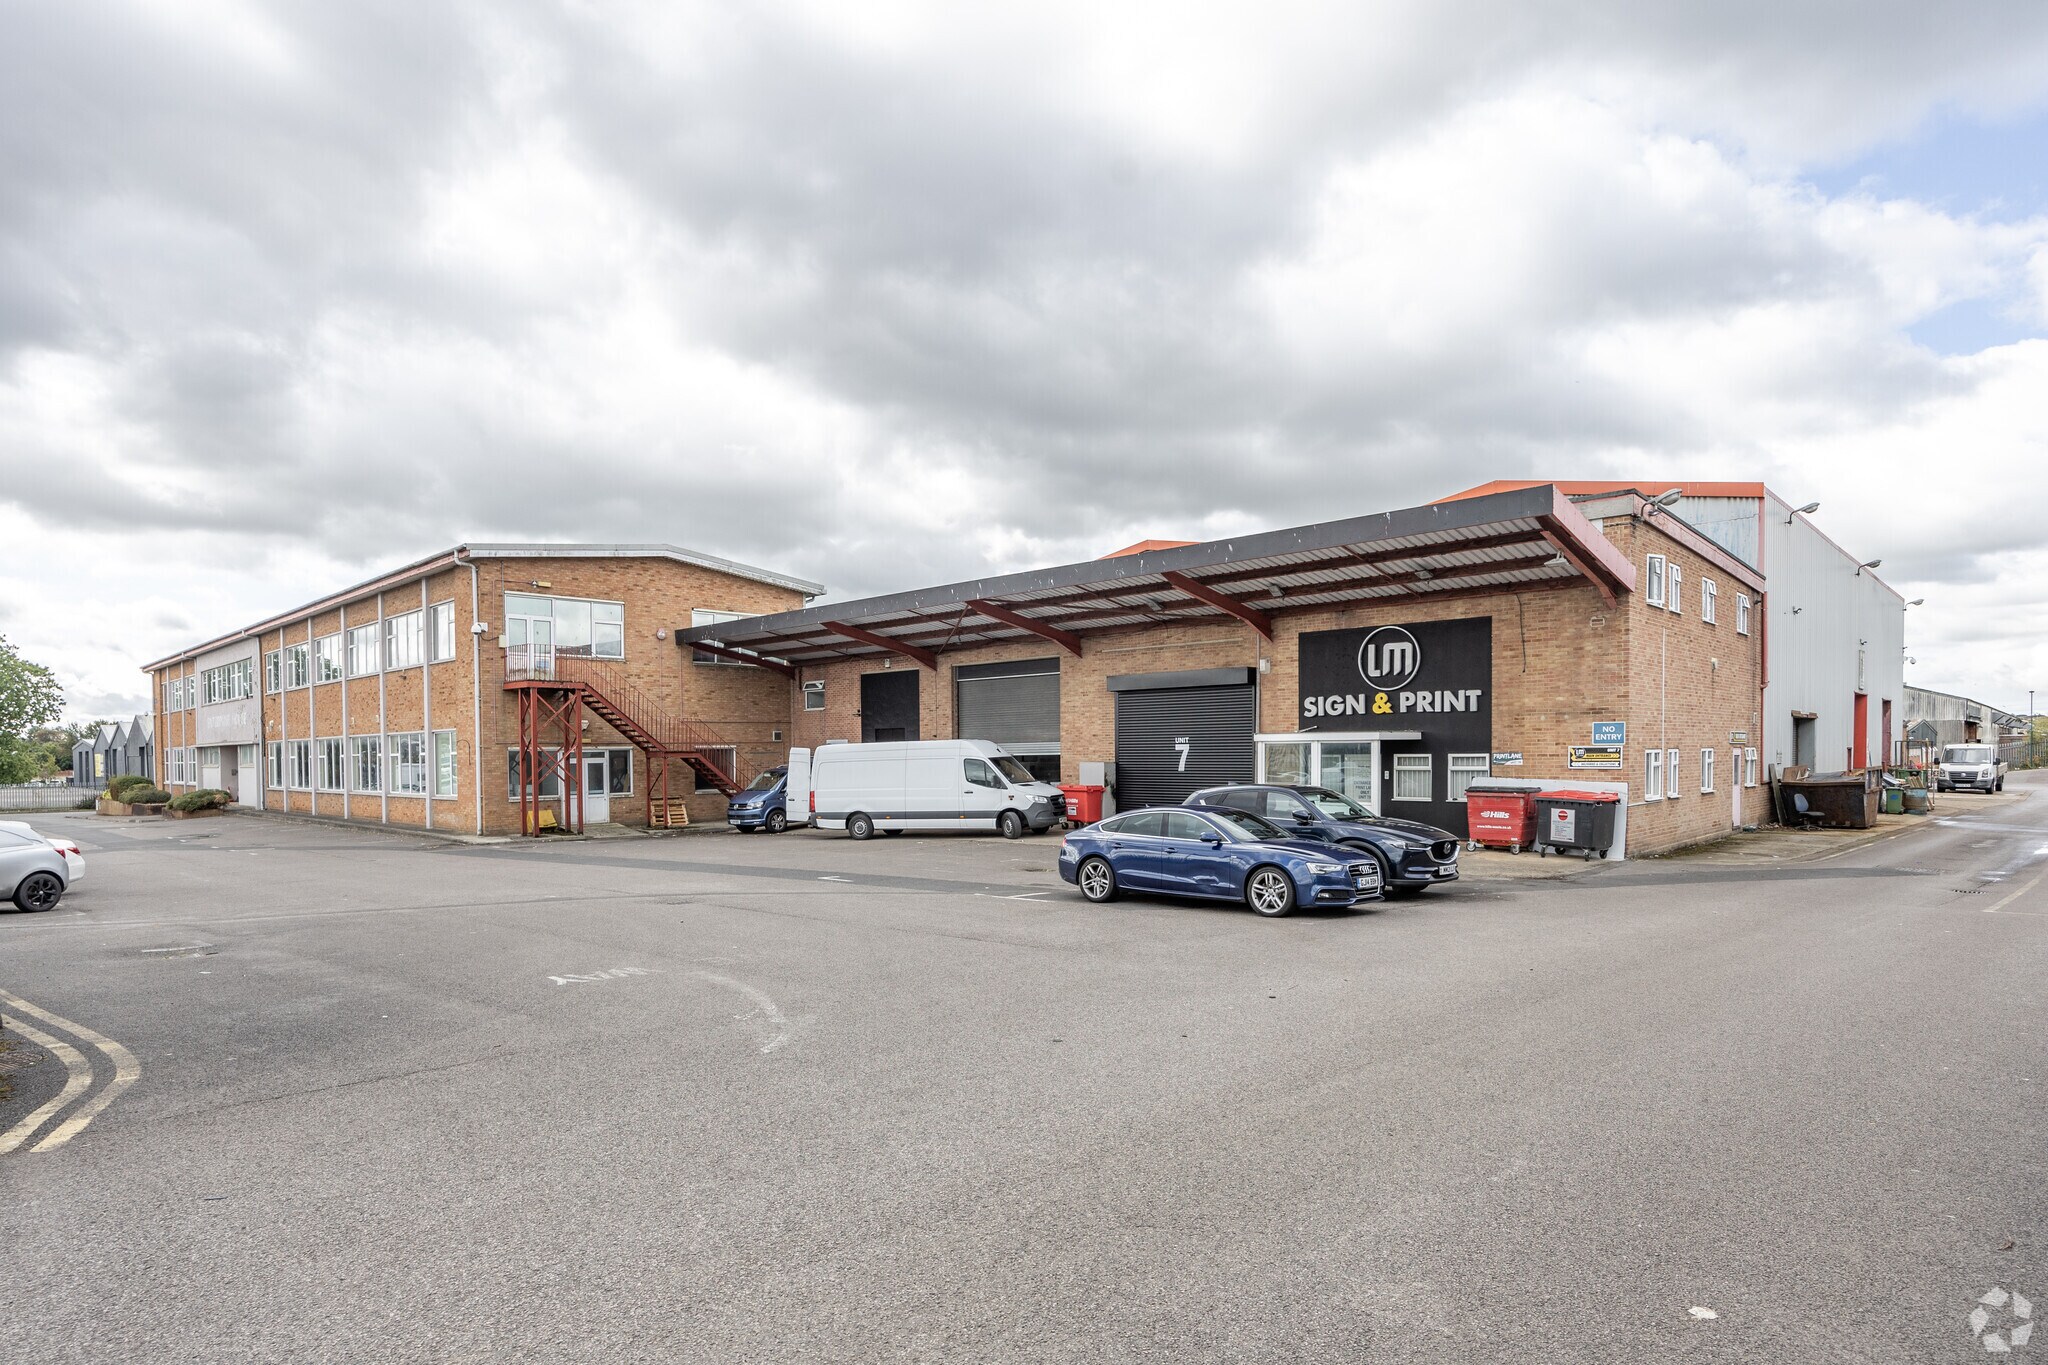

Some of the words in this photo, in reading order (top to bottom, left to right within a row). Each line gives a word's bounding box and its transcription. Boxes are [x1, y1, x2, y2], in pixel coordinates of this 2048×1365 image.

[1303, 693, 1367, 718] SIGN
[1372, 692, 1394, 715] &
[1400, 689, 1482, 713] PRINT
[1602, 725, 1616, 733] NO
[1595, 733, 1622, 741] ENTRY
[1175, 744, 1190, 772] 7
[1490, 811, 1510, 819] Hills
